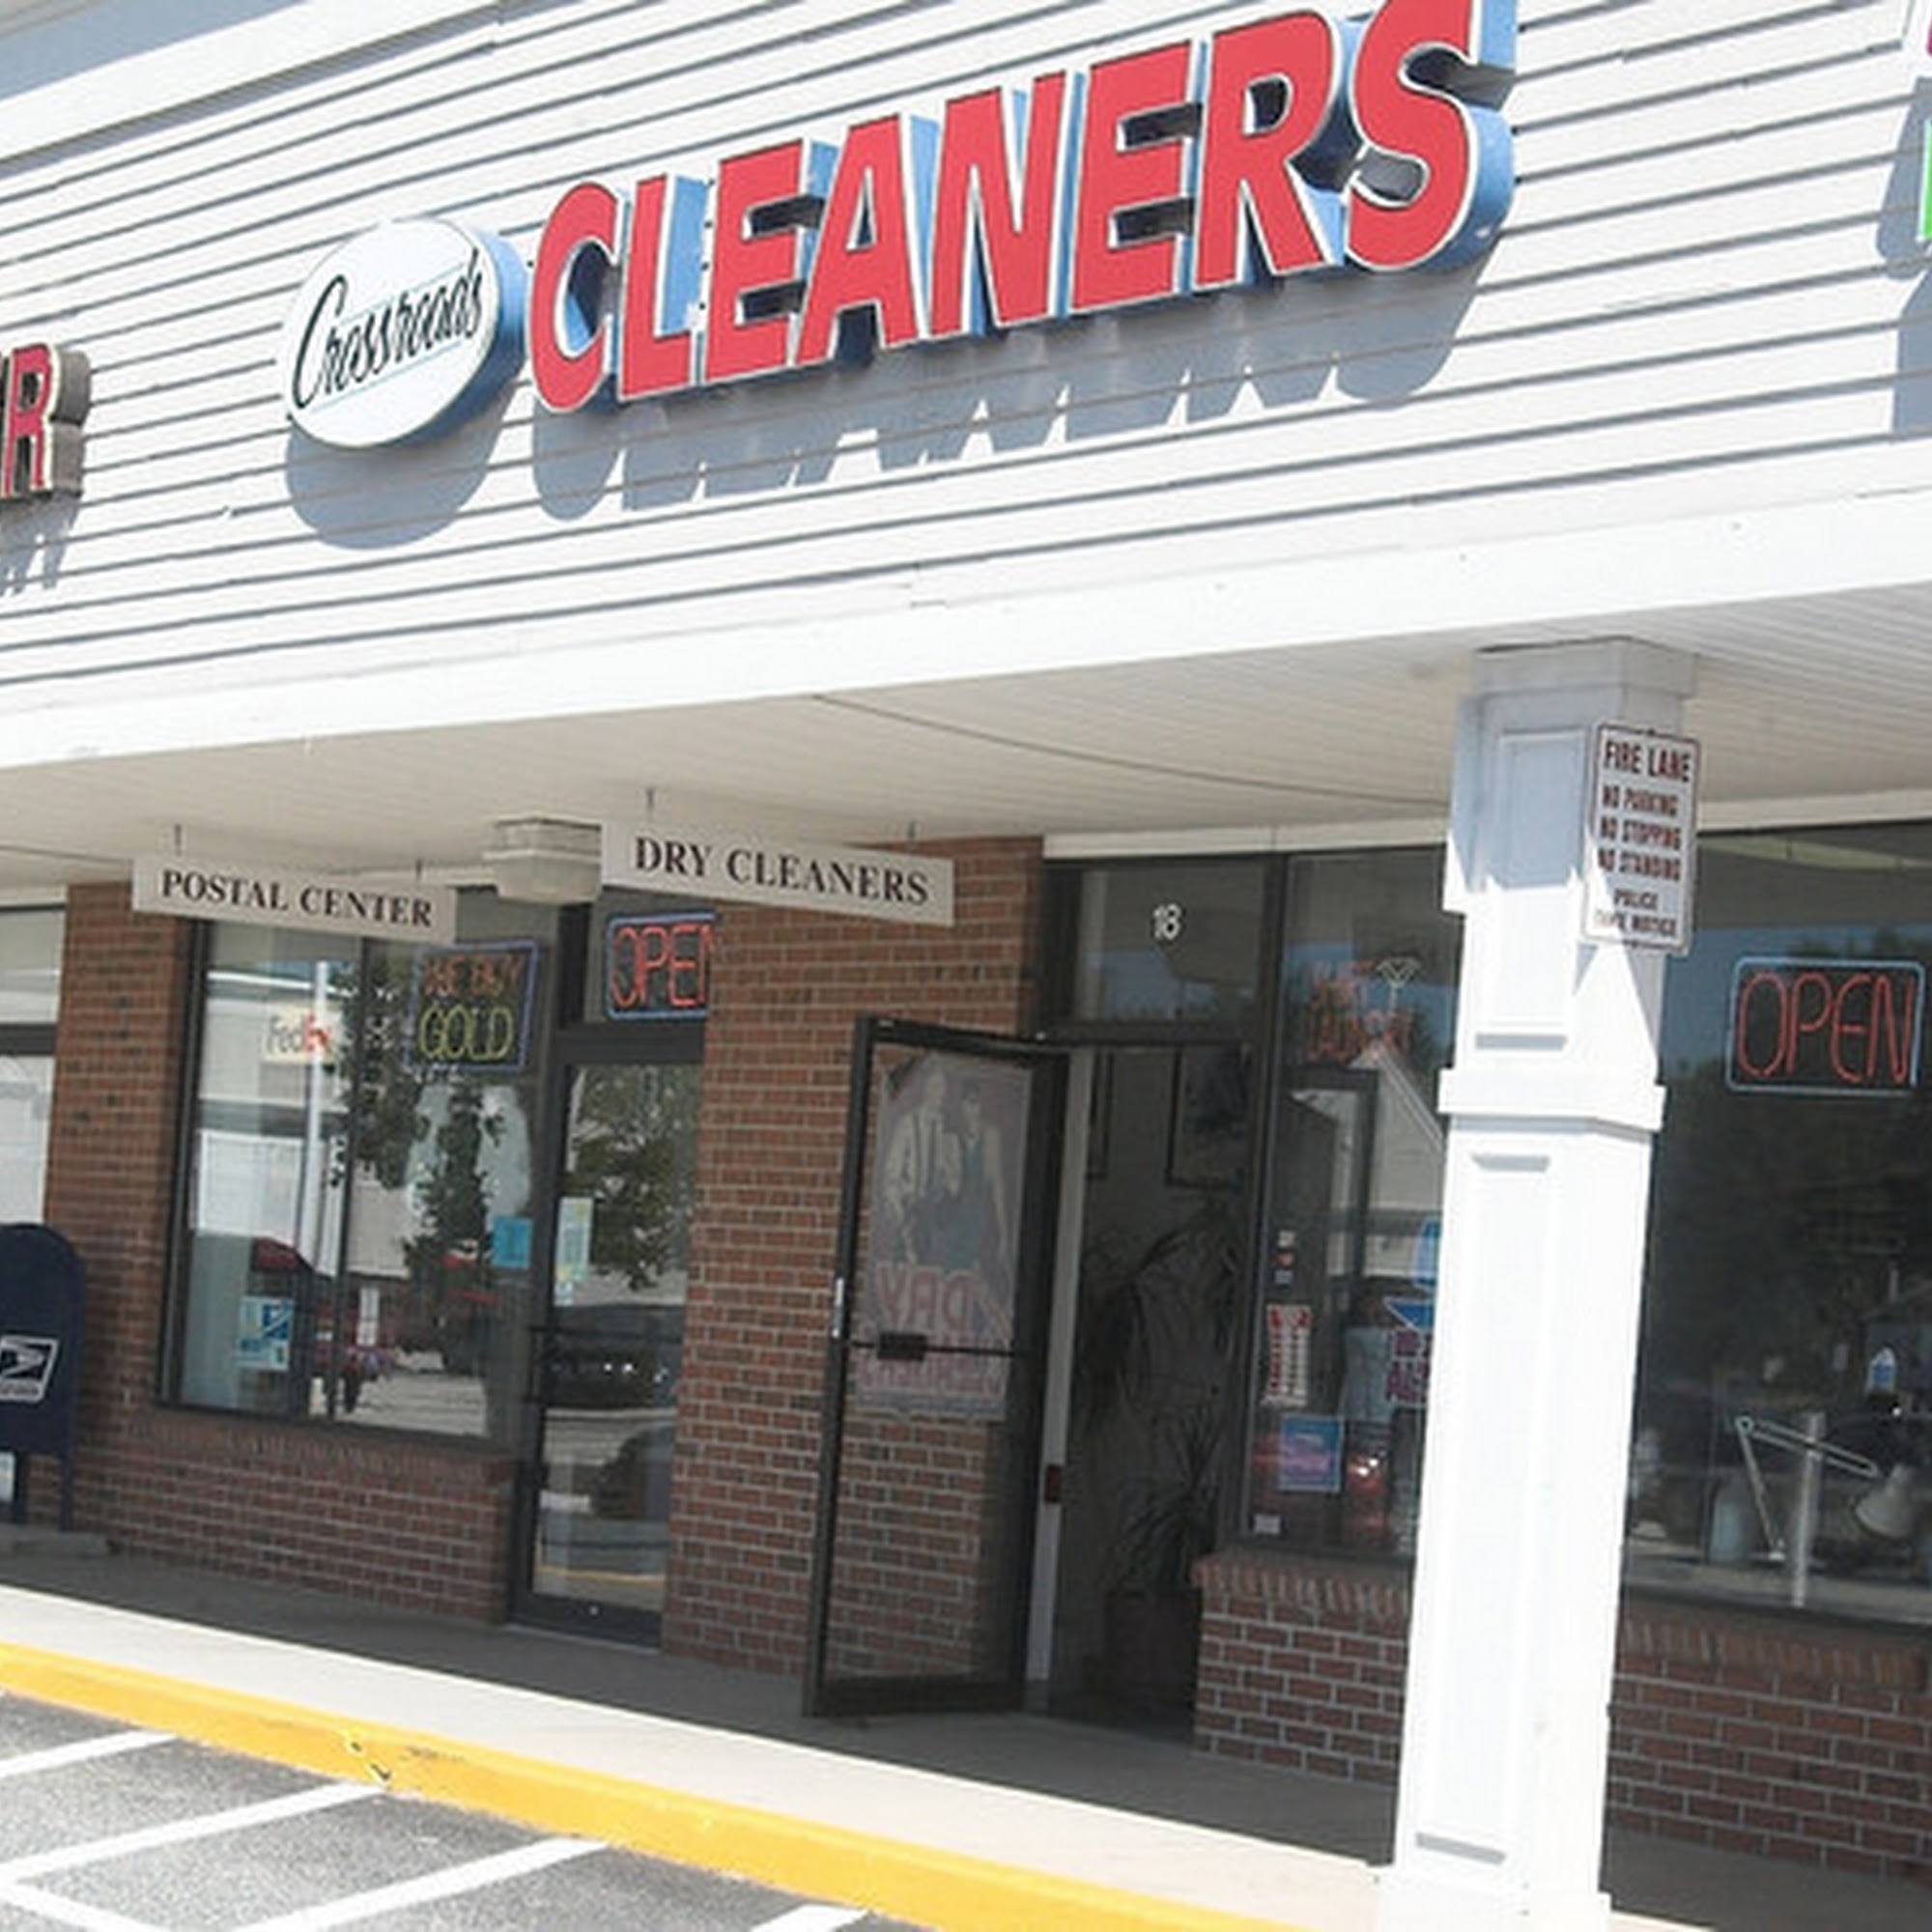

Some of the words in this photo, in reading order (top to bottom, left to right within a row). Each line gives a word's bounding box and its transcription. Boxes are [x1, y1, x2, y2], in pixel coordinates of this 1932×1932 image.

[526, 0, 1480, 413] CLEANERS
[292, 246, 484, 410] Crossroads
[1604, 739, 1641, 775] FIRE
[1648, 747, 1690, 783] LANE
[1603, 785, 1620, 809] NO
[1624, 787, 1679, 817] PARKING
[1600, 815, 1617, 840] NO
[1622, 818, 1681, 851] STOPPING
[635, 836, 711, 877] DRY
[726, 848, 929, 906] CLEANERS
[1597, 848, 1615, 873] NO
[1619, 850, 1681, 882] STANDING
[161, 868, 289, 912] POSTAL
[299, 885, 433, 927] CENTER
[1613, 887, 1659, 912] POLICE
[418, 1003, 515, 1061] GOLD
[1739, 971, 1916, 1085] OPEN
